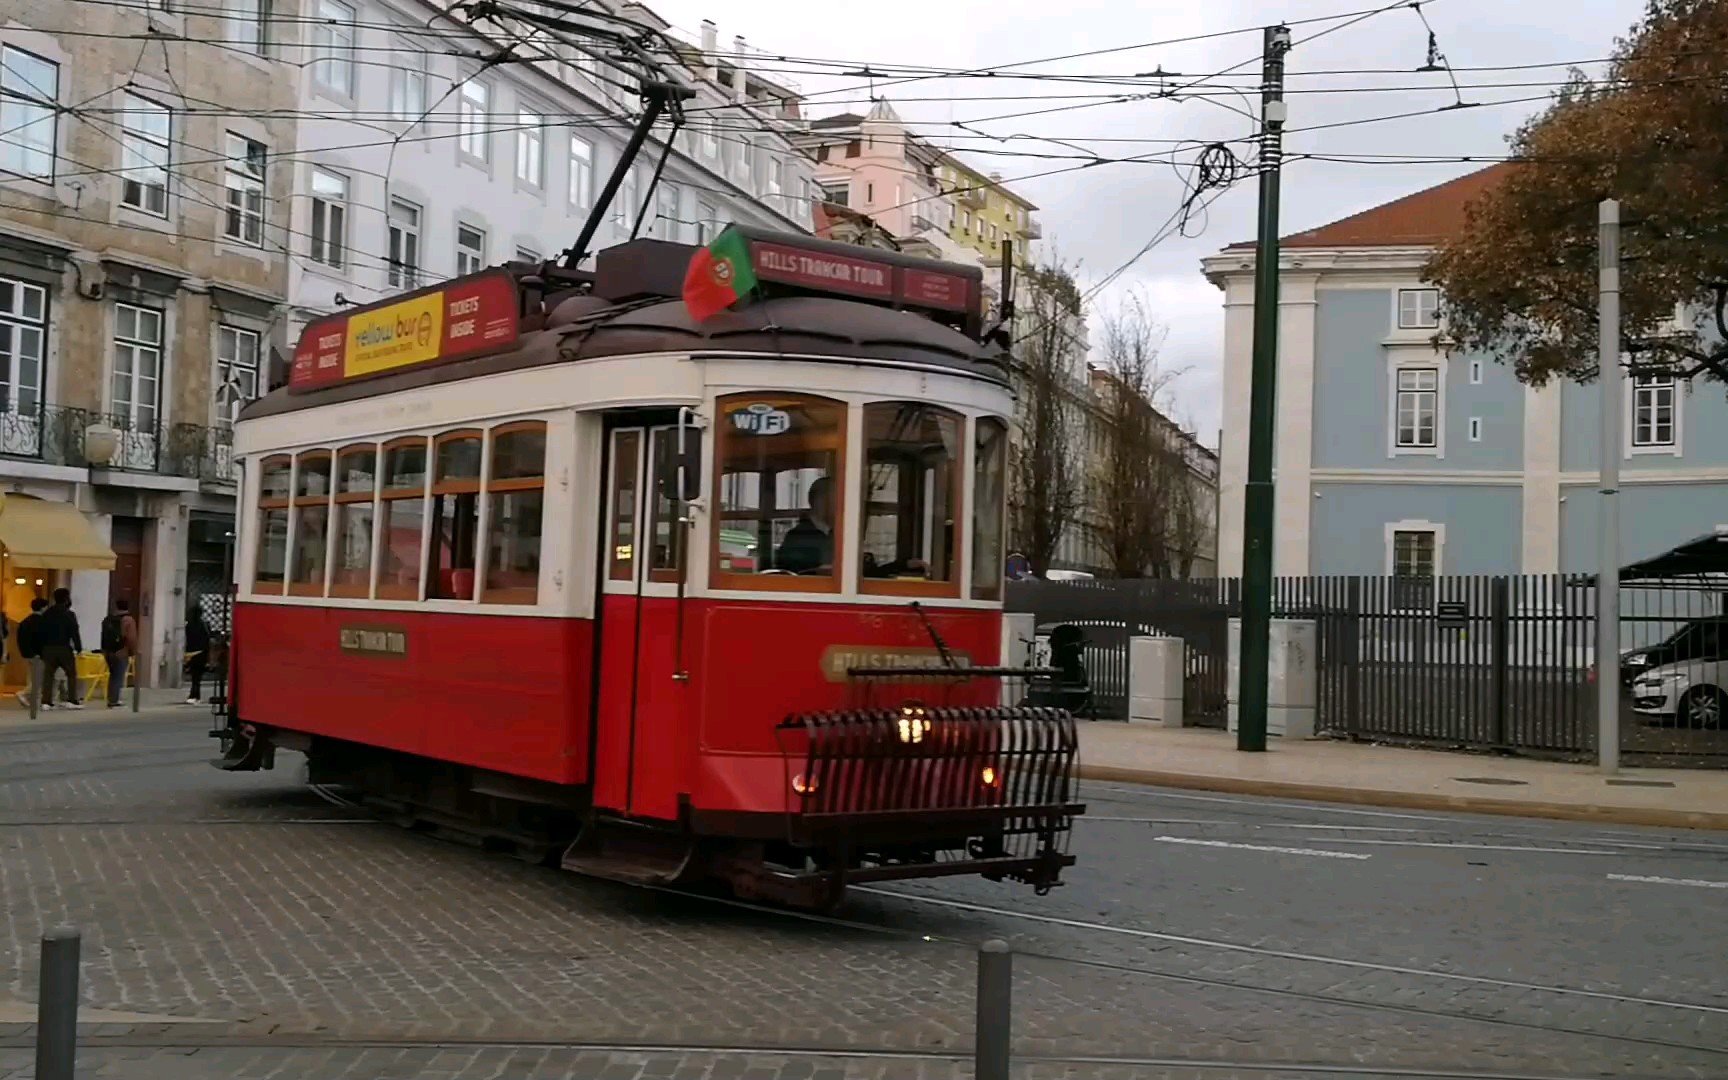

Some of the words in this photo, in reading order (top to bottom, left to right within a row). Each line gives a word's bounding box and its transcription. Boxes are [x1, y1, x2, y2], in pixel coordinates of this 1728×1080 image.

[759, 250, 798, 273] HILLS
[853, 265, 884, 286] TOUR
[450, 295, 480, 316] TICKETS
[450, 318, 475, 339] INSIDE
